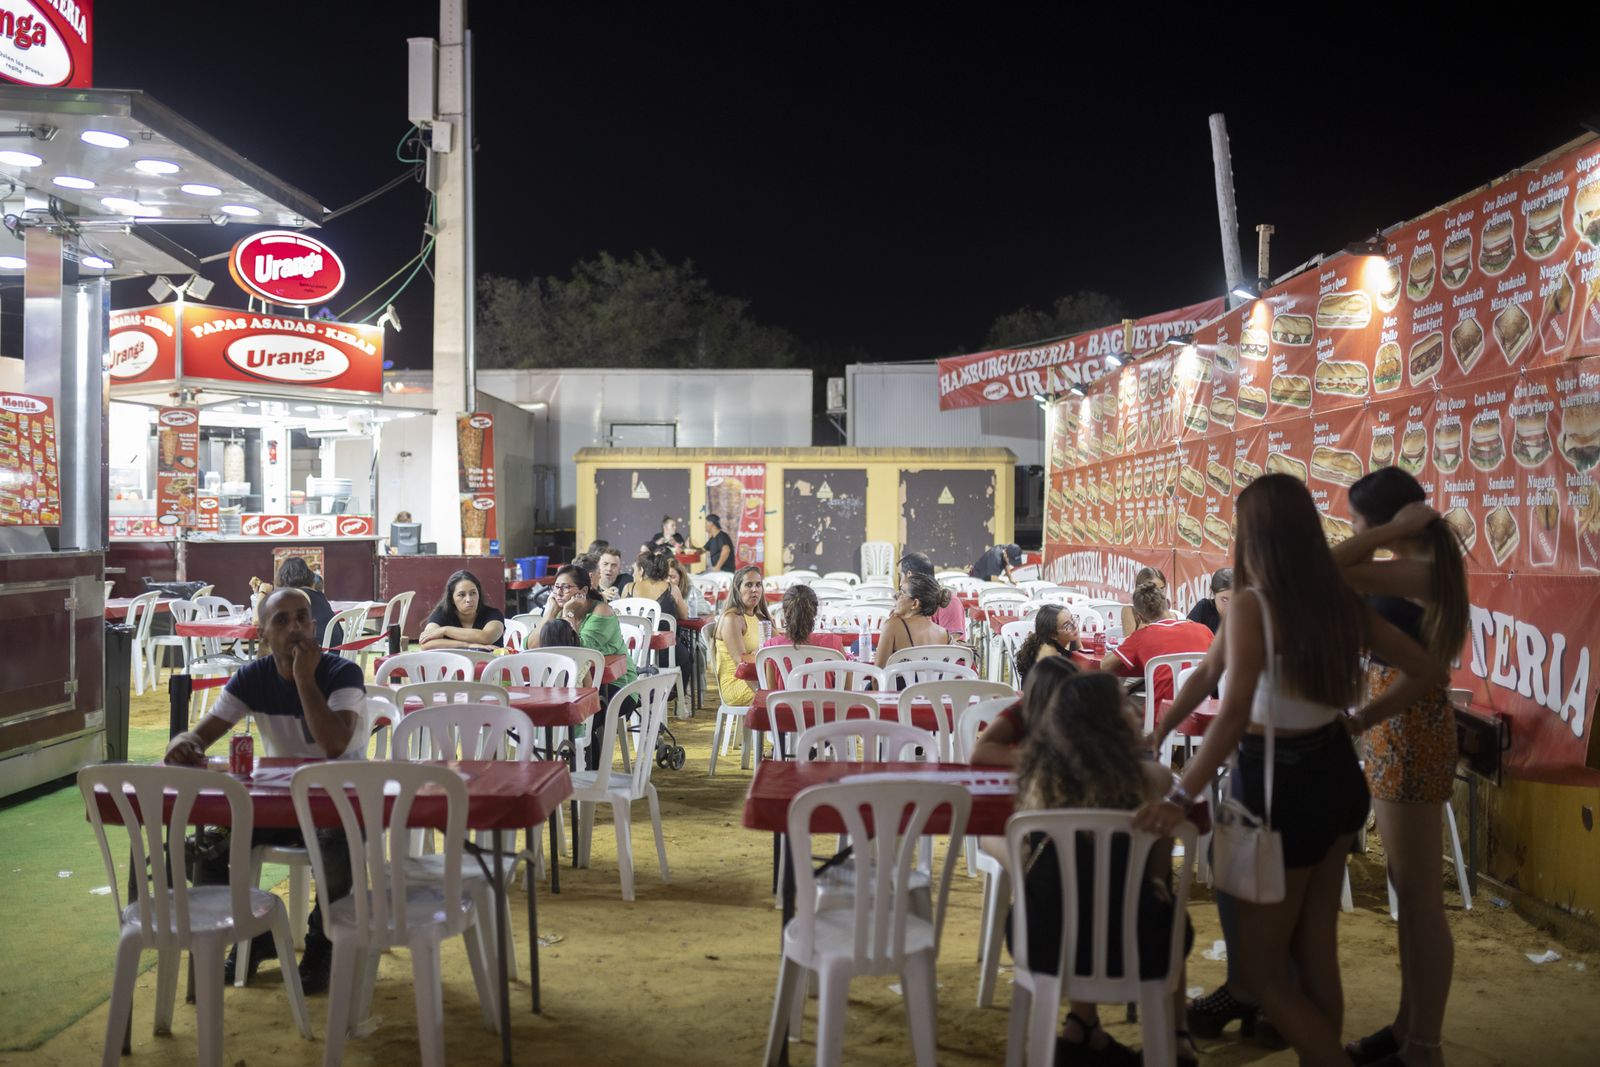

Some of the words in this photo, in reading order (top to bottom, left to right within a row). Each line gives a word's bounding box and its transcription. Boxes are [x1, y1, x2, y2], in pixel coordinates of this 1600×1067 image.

[1527, 181, 1541, 195] Con
[1482, 201, 1496, 215] Con
[1444, 217, 1457, 231] Con
[1417, 229, 1430, 242] Con
[254, 252, 323, 284] Uranga
[1496, 272, 1528, 294] Sandwich
[1452, 286, 1484, 308] Sandwich
[1412, 301, 1444, 320] Salchicha
[190, 317, 248, 339] PAPAS
[250, 317, 317, 335] ASADAS
[1382, 315, 1398, 329] Mac
[1412, 316, 1444, 335] Frankfurt
[1380, 329, 1399, 344] Pollo
[246, 348, 325, 369] Uranga
[939, 341, 1076, 397] HAMBURGUESERIA
[1513, 384, 1527, 399] Con
[1555, 377, 1578, 394] Super
[1, 397, 37, 409] Menús
[1435, 399, 1448, 412] Con
[1448, 397, 1466, 413] Queso
[1473, 393, 1486, 407] Con
[1486, 390, 1506, 405] Beicon
[1378, 410, 1390, 423] Con
[1408, 405, 1422, 417] Con
[735, 465, 764, 477] Kebab
[1443, 479, 1476, 493] Sandwich
[1488, 475, 1516, 491] Sandwich
[1526, 474, 1556, 491] Nuggets
[1449, 495, 1469, 509] Mixto
[1482, 493, 1498, 508] Mixto
[1526, 492, 1536, 507] de
[1535, 490, 1554, 507] Pollo
[1567, 490, 1590, 507] Fritas
[1469, 602, 1590, 738] TERIA
